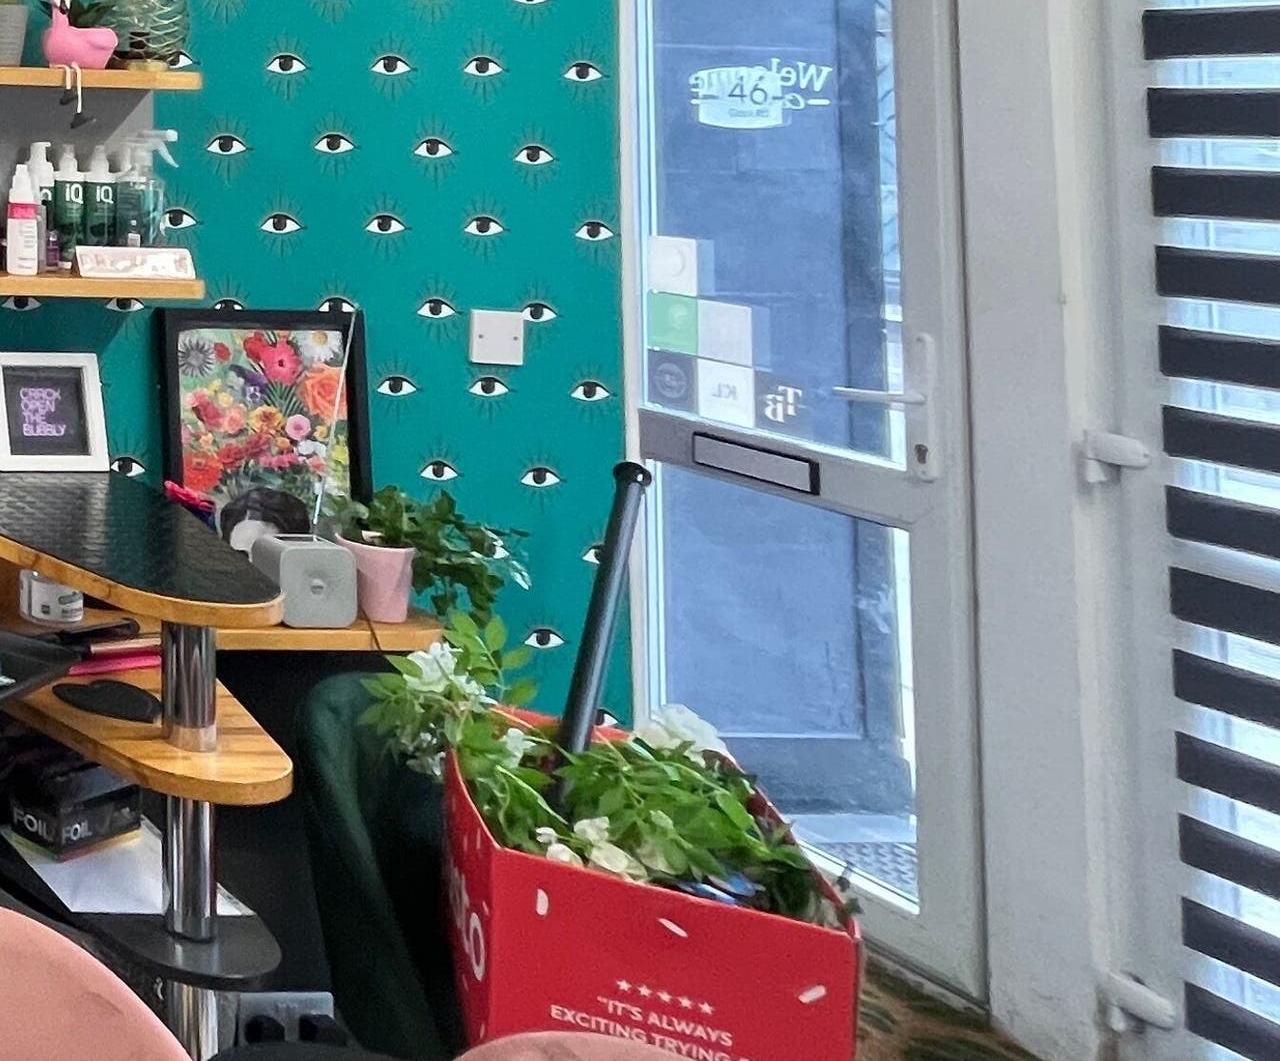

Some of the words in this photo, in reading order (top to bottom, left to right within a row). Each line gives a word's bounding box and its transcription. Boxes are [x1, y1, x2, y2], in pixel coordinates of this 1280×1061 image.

[61, 822, 93, 845] FOIL
[550, 1004, 648, 1044] EXCITING
[648, 1012, 733, 1047] ALWAYS
